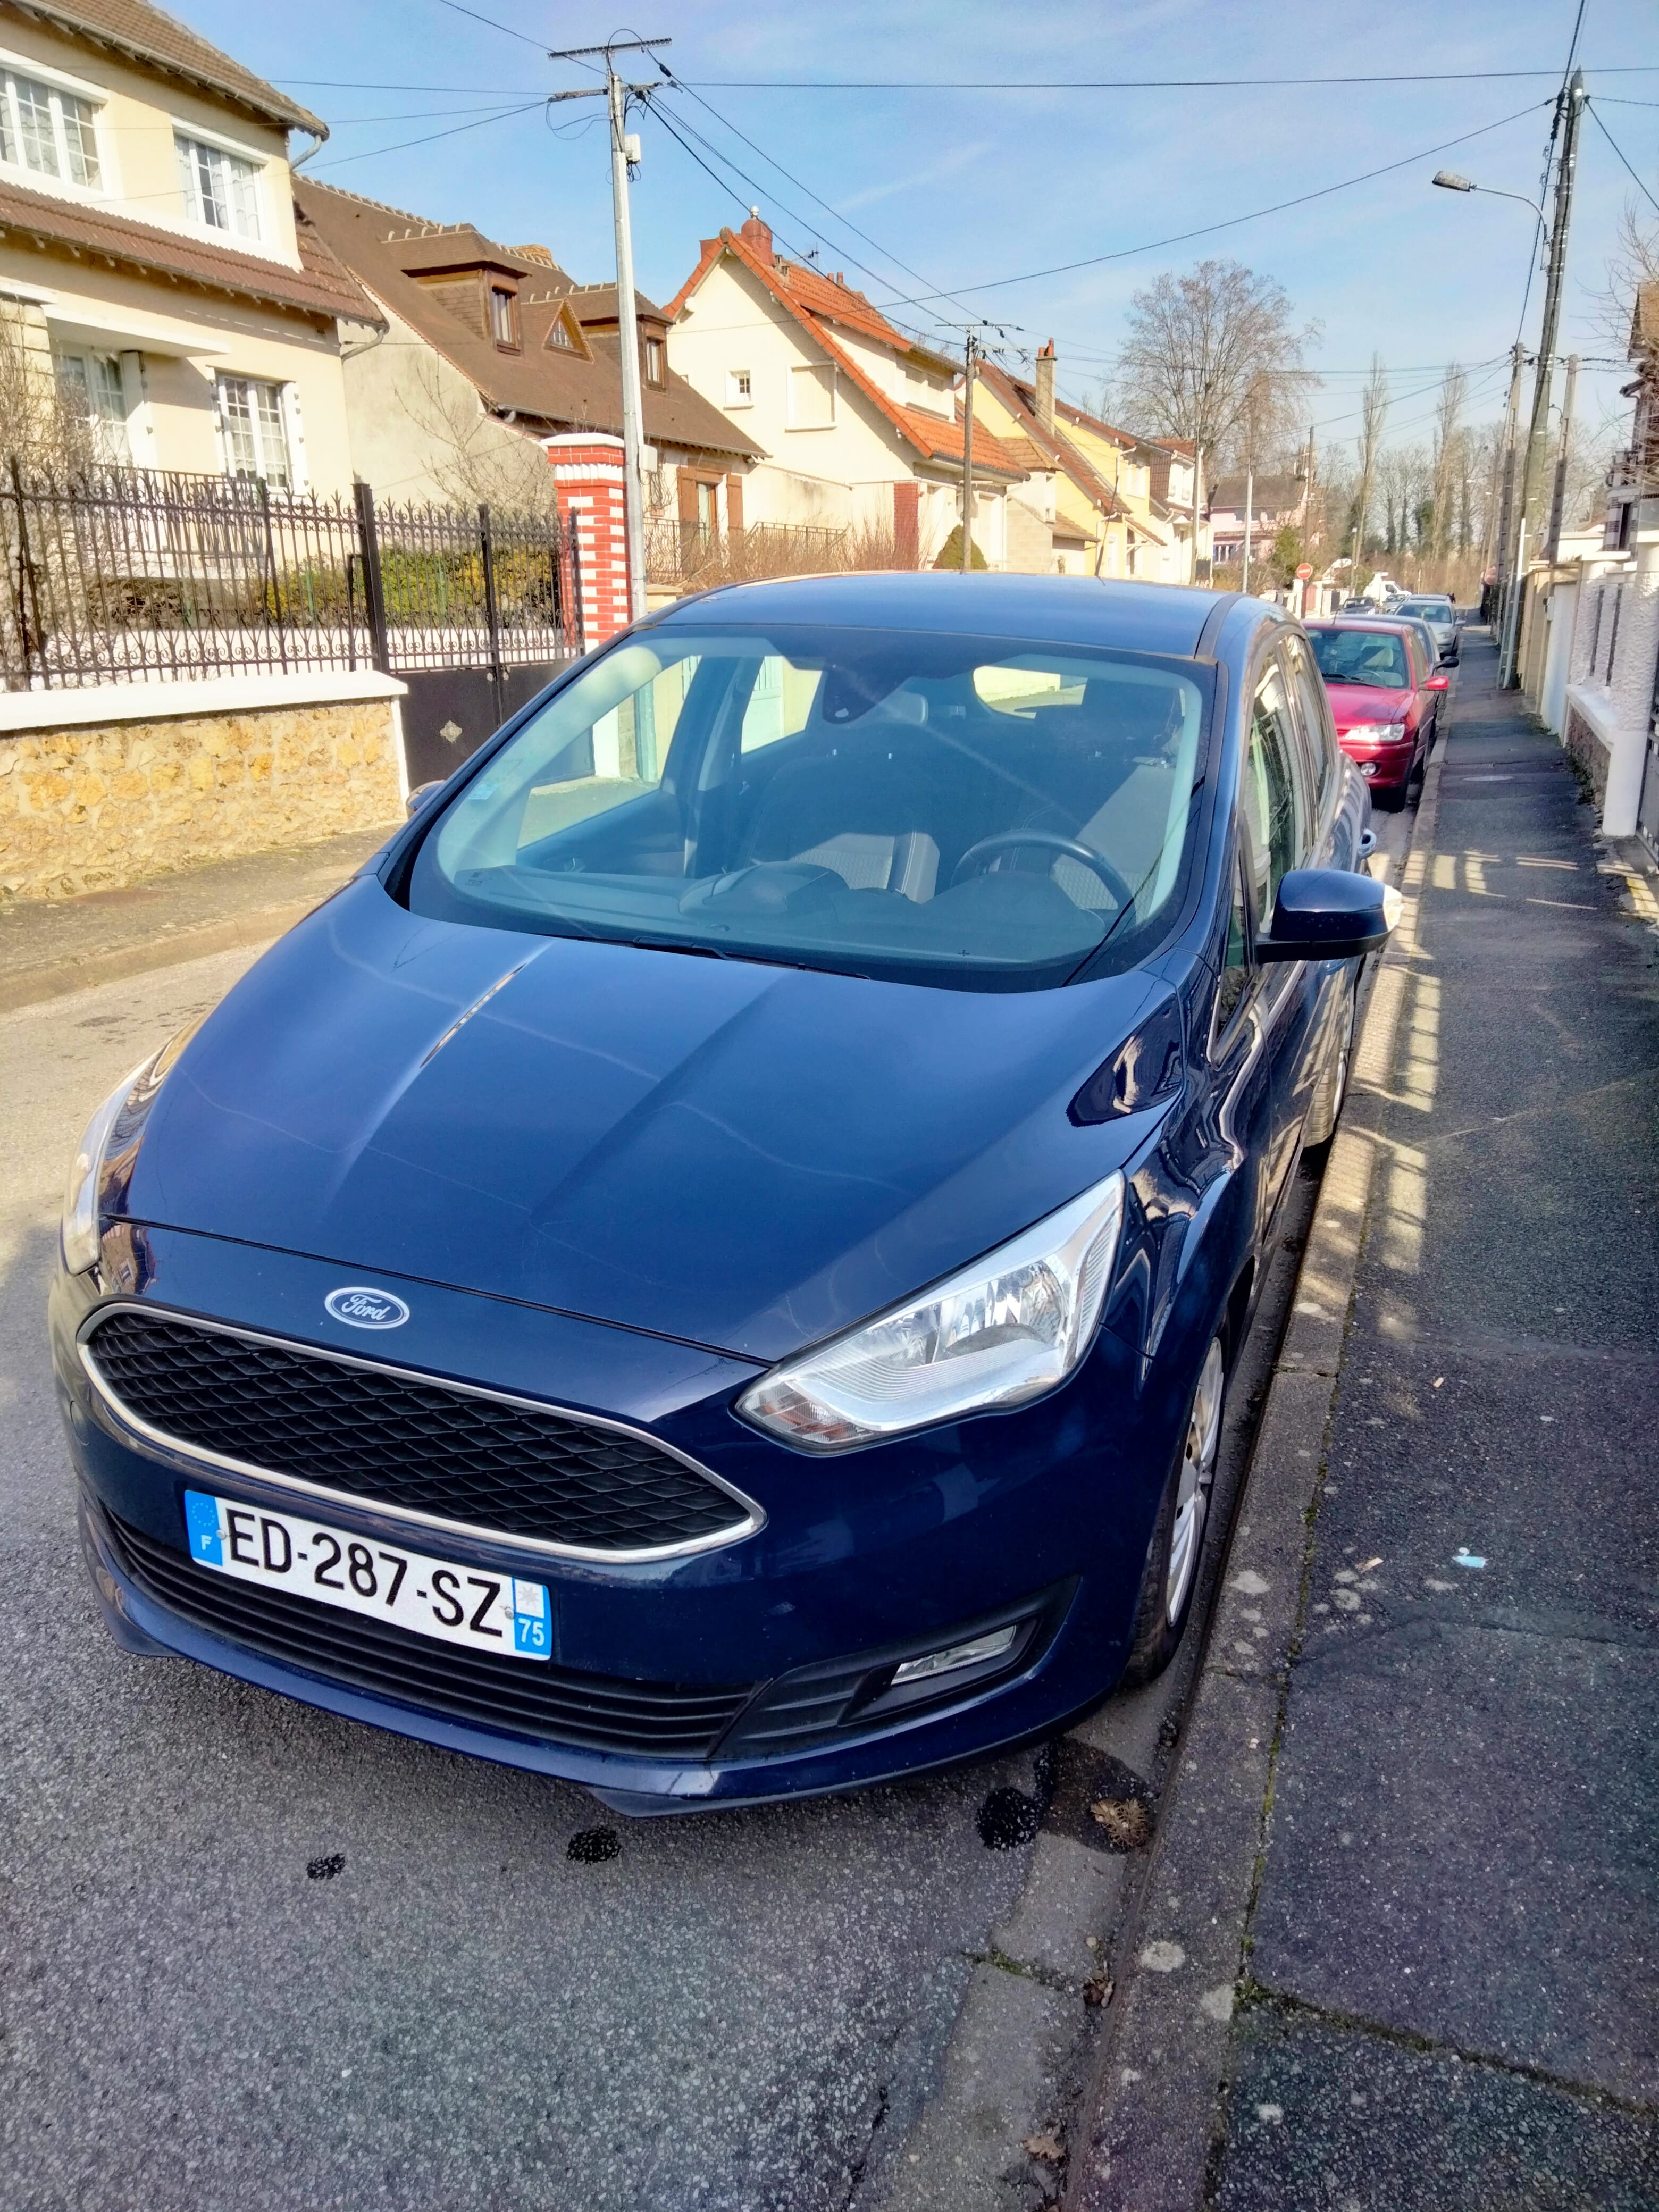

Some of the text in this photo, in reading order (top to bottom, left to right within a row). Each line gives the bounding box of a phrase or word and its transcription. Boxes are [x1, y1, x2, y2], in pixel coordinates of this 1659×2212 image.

[341, 1294, 391, 1320] Ford
[200, 1535, 212, 1551] F
[225, 1508, 503, 1638] ED-287-SZ
[518, 1618, 545, 1647] 75
